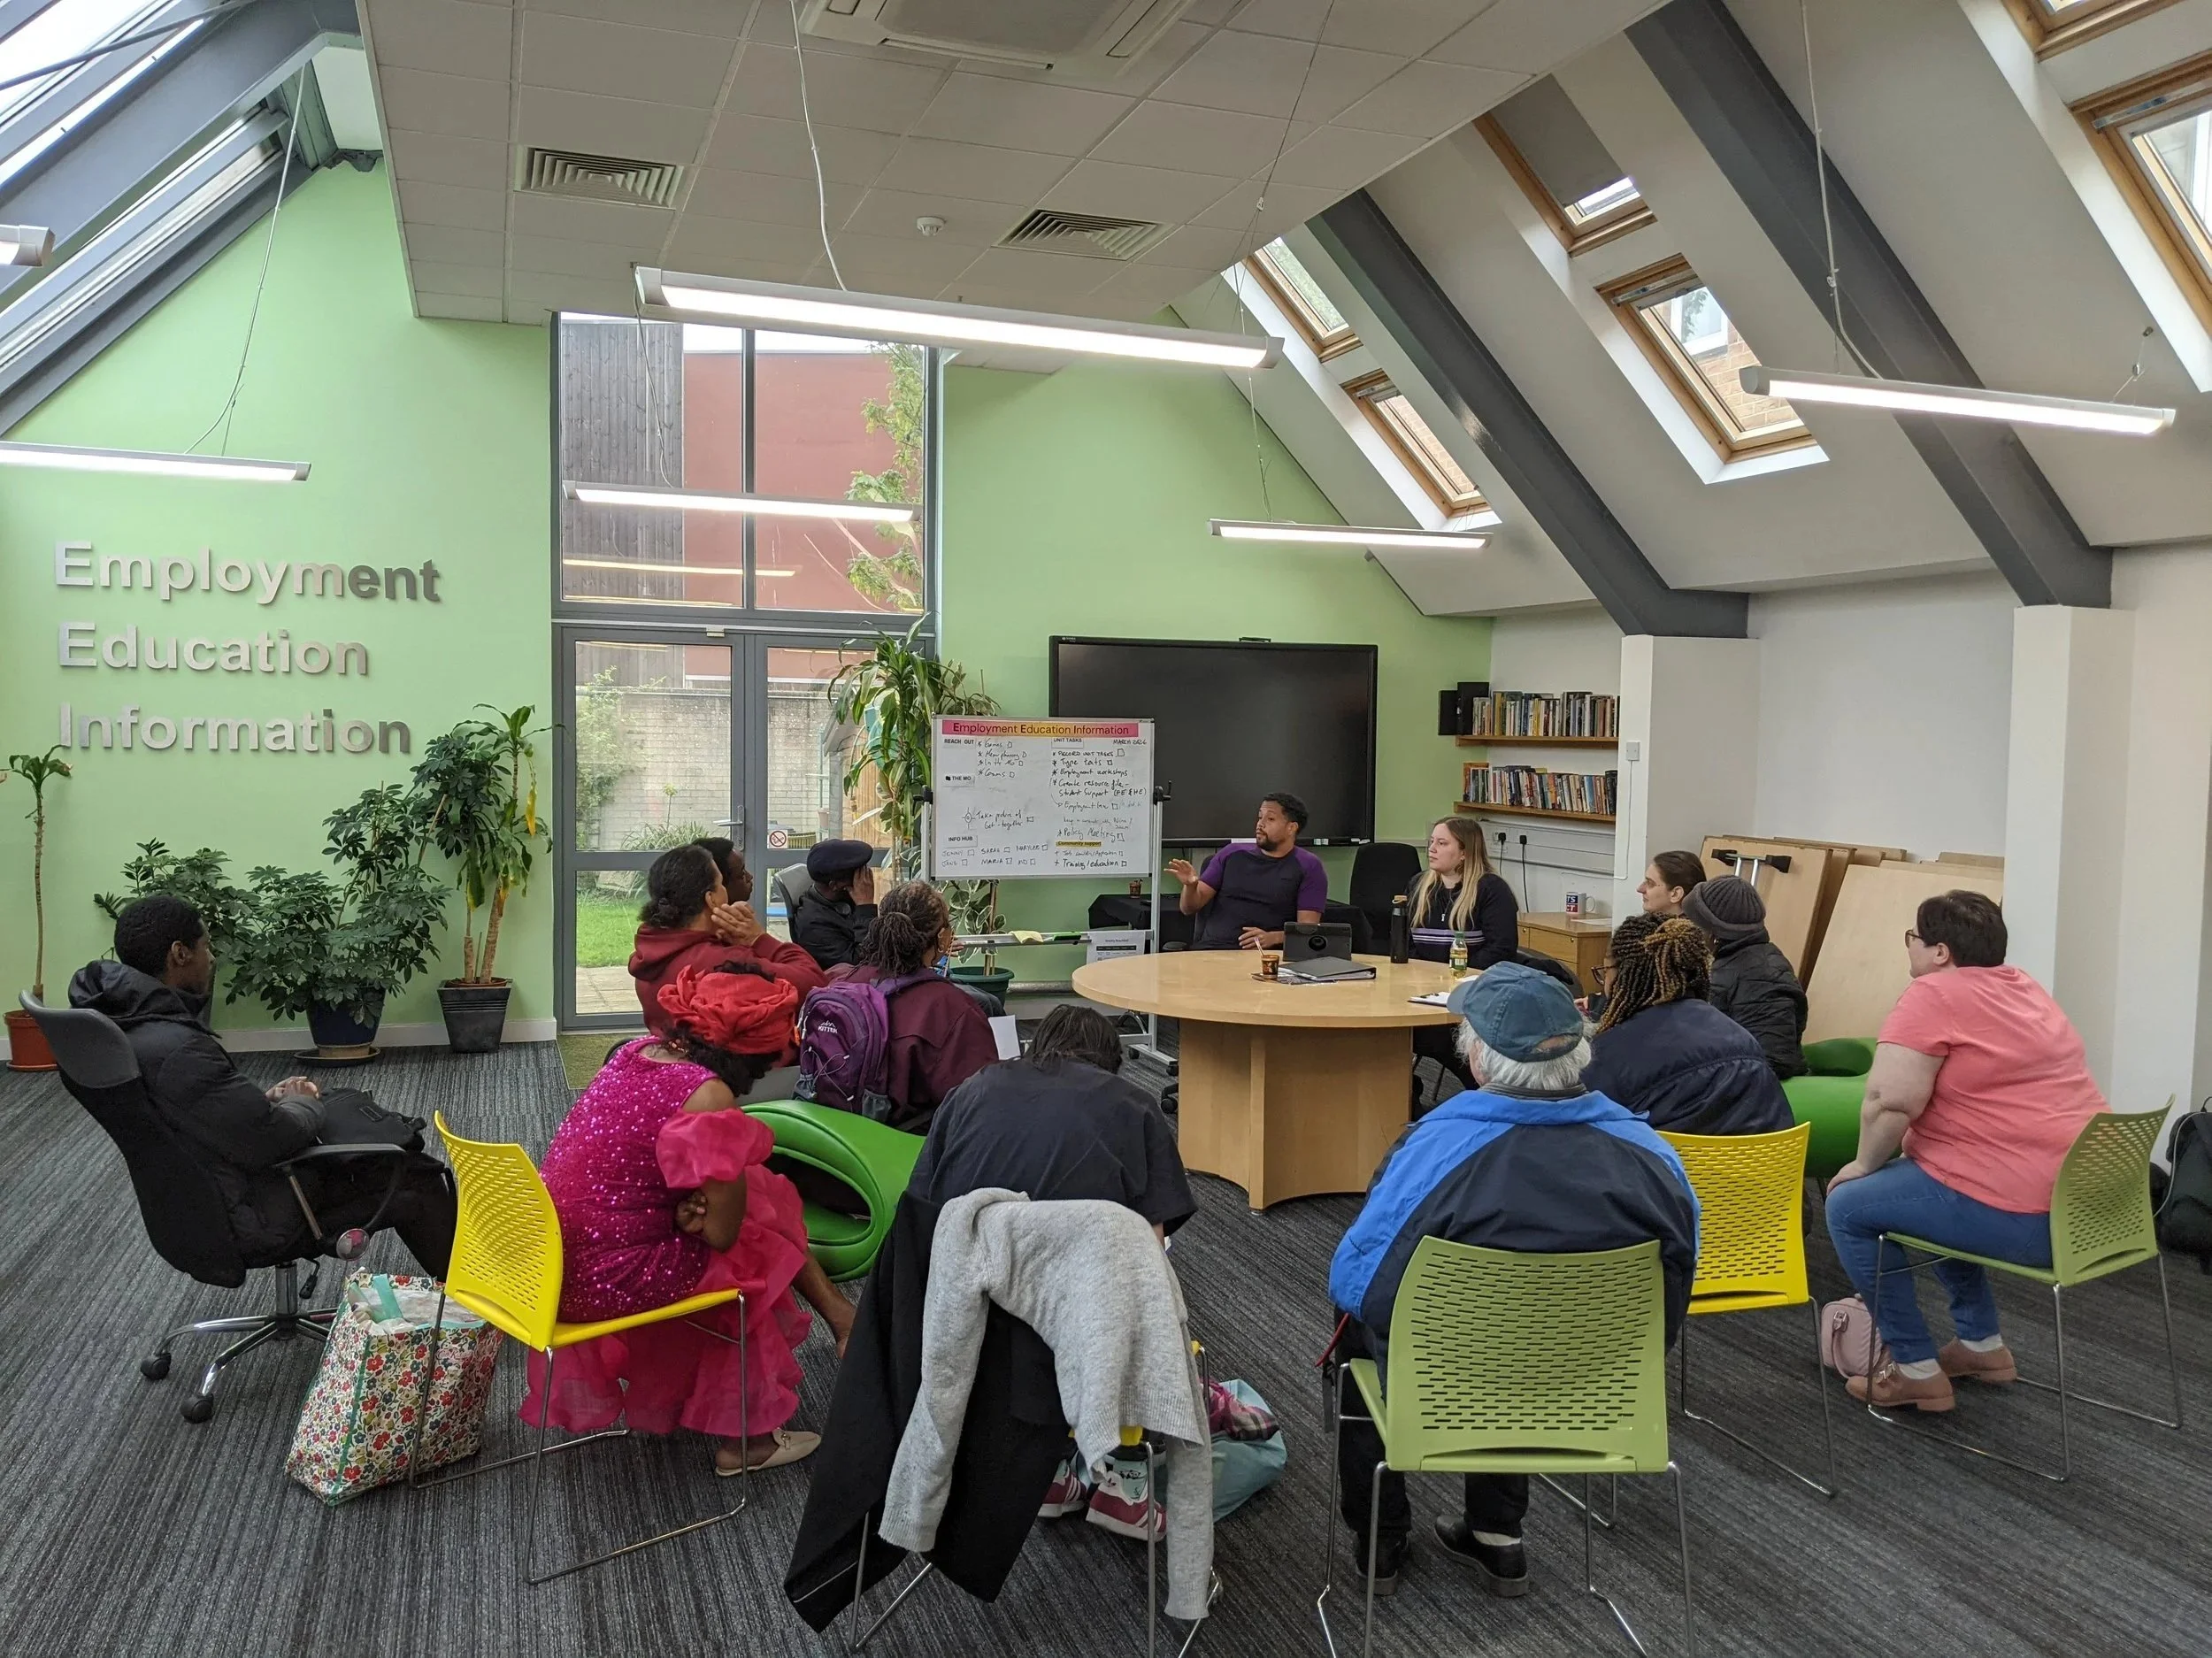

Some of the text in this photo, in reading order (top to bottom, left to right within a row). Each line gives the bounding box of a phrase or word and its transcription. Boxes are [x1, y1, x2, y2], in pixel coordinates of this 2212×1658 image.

[55, 541, 441, 603] Employment
[58, 622, 368, 675] Education
[59, 702, 411, 754] Information
[953, 723, 1129, 735] Employment Education Information
[1060, 757, 1079, 768] Type
[1060, 768, 1128, 778] Employment workshops
[1111, 779, 1124, 790] file
[1084, 787, 1109, 799] Support
[1064, 801, 1095, 812] Employment
[1064, 827, 1116, 843] Policy Meeting
